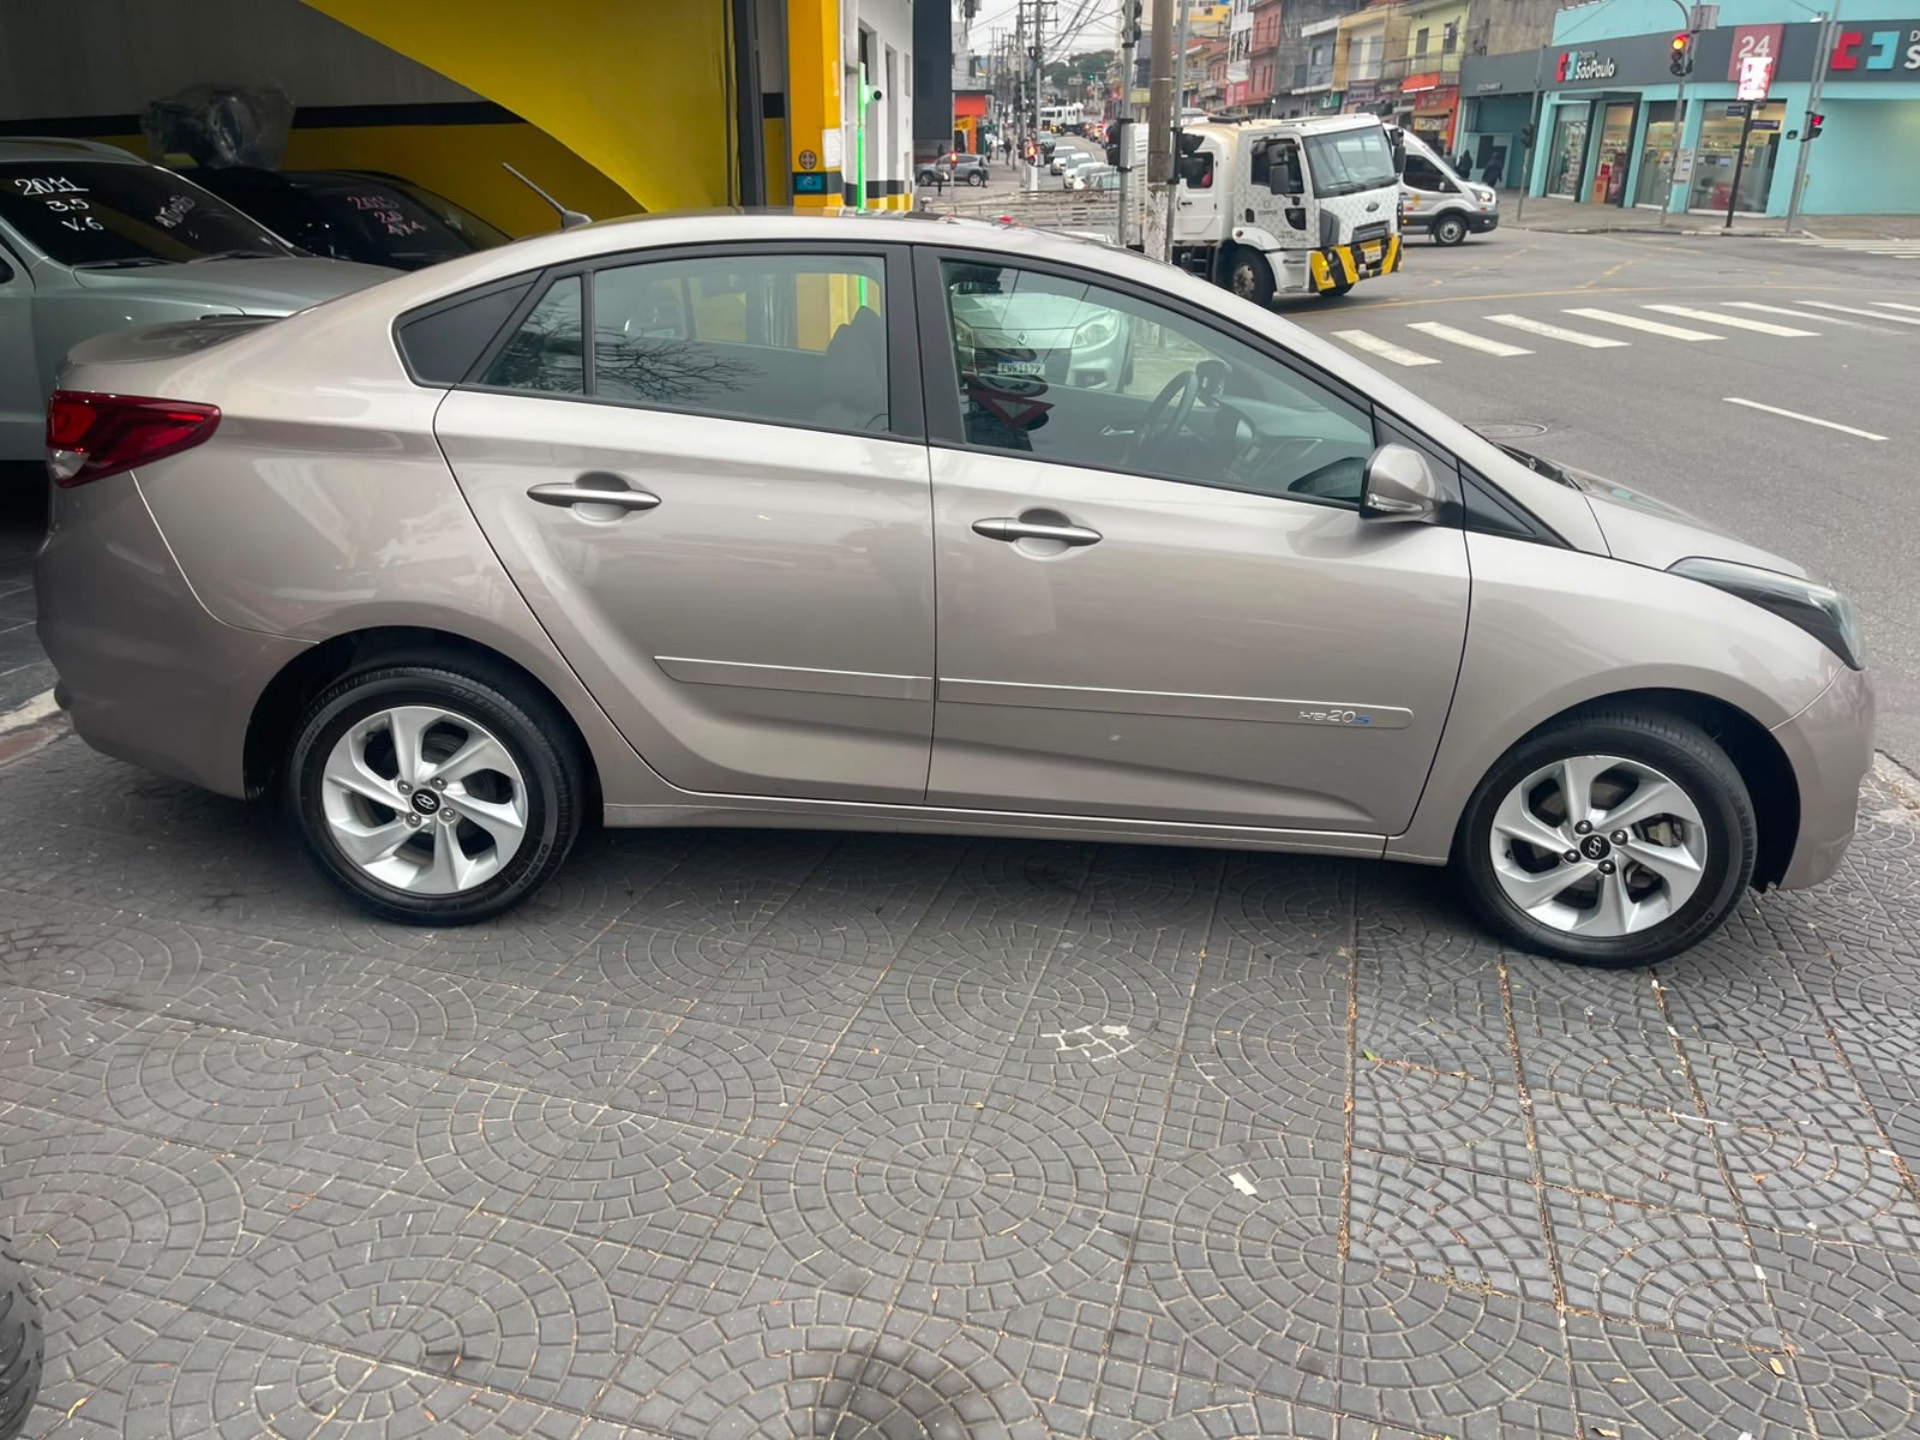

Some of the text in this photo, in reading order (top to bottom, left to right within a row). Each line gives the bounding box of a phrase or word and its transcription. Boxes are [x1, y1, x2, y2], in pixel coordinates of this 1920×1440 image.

[1738, 35, 1770, 58] 24
[14, 177, 90, 195] 2011
[45, 198, 90, 212] 3.5
